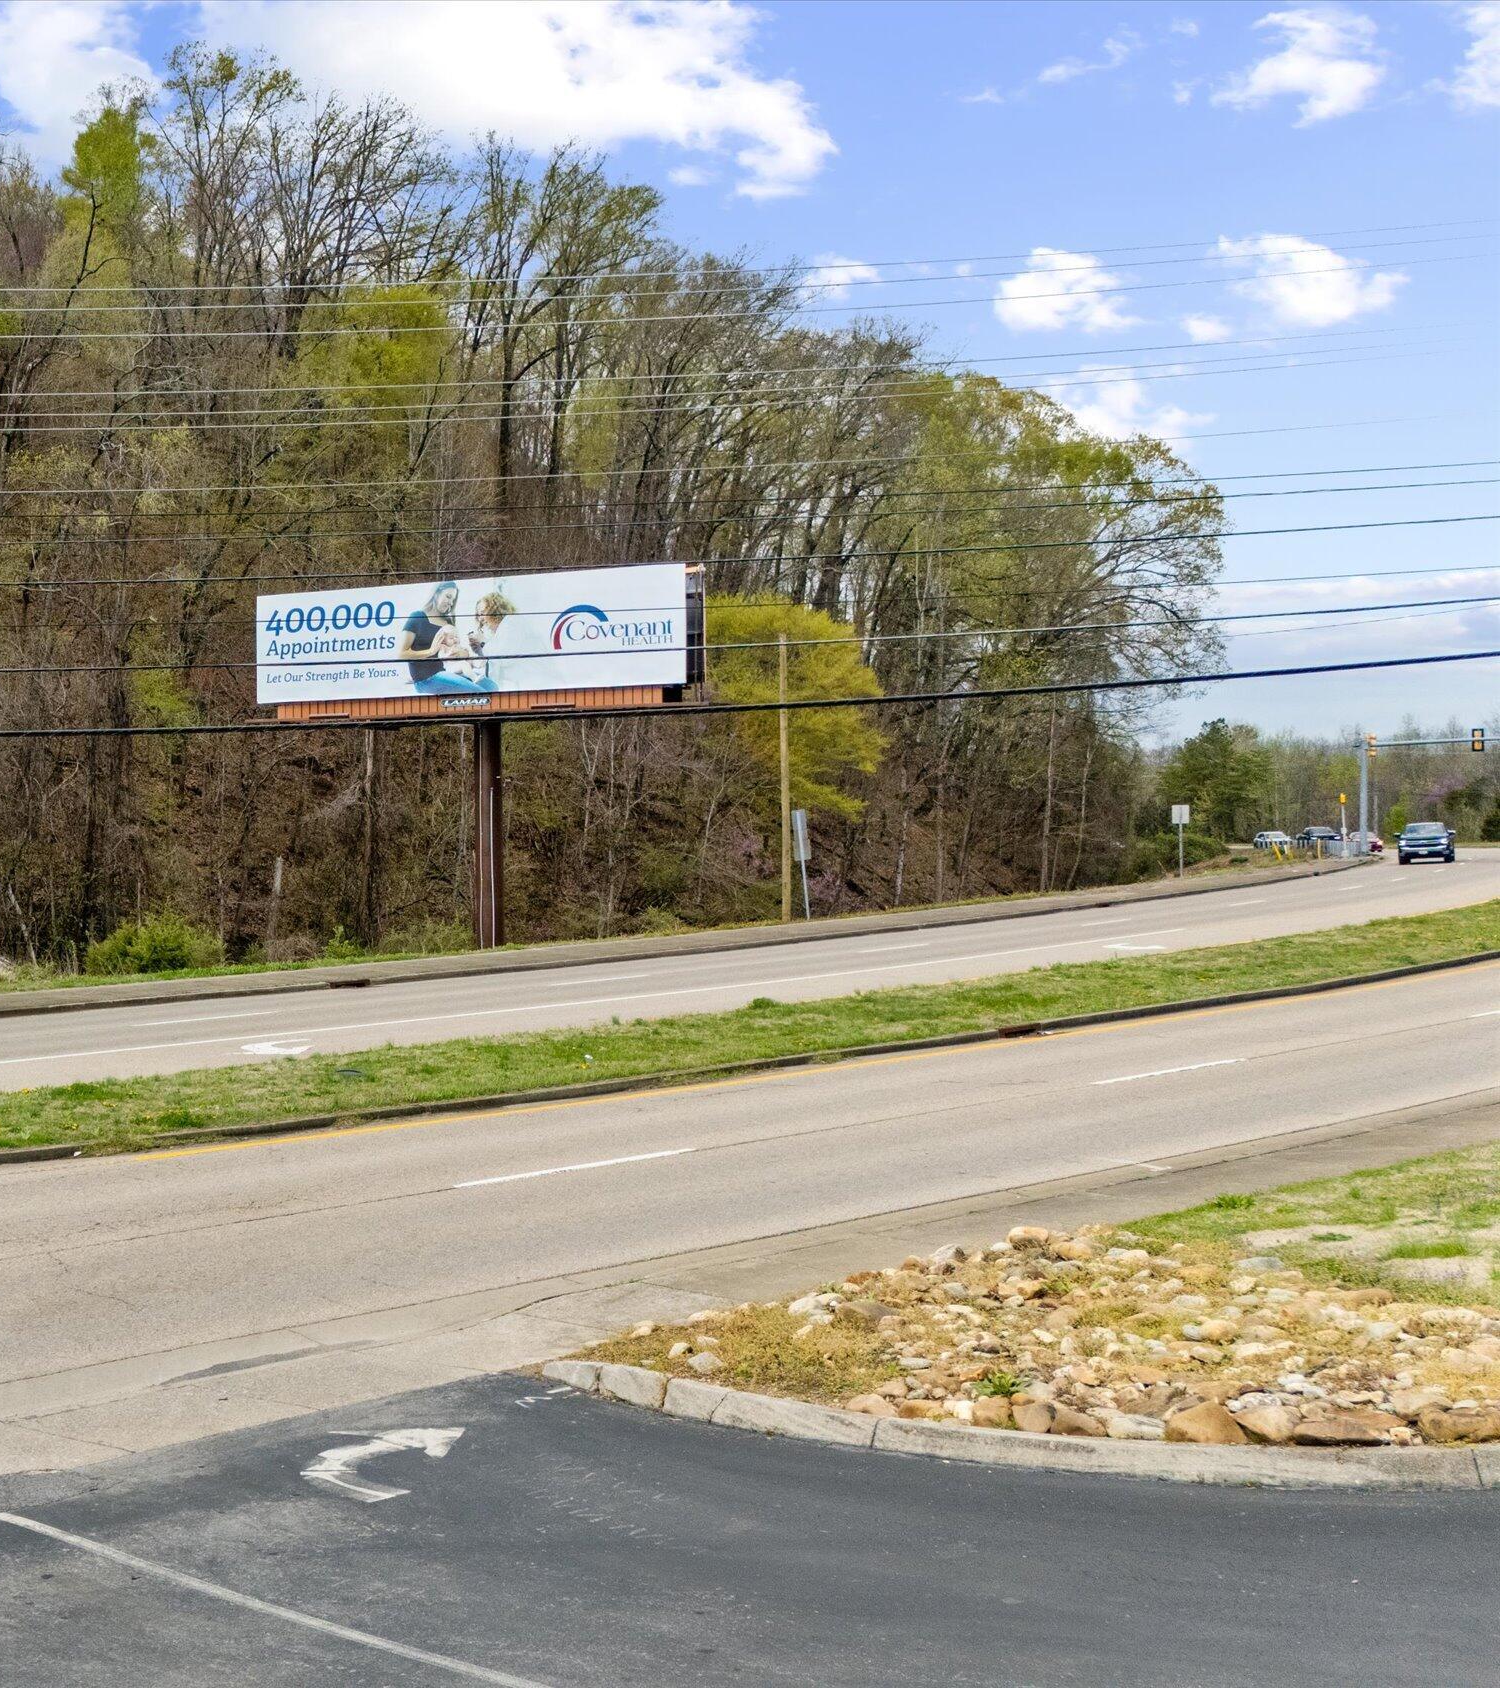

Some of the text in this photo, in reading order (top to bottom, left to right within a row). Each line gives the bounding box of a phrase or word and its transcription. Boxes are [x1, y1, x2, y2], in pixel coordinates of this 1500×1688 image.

[265, 601, 395, 636] 400,000
[565, 618, 673, 641] Covenant
[266, 634, 396, 659] Appointments
[621, 634, 674, 646] HEALTH
[266, 667, 400, 684] Let Our Strength Be Yours.
[444, 698, 489, 706] LAMAR
